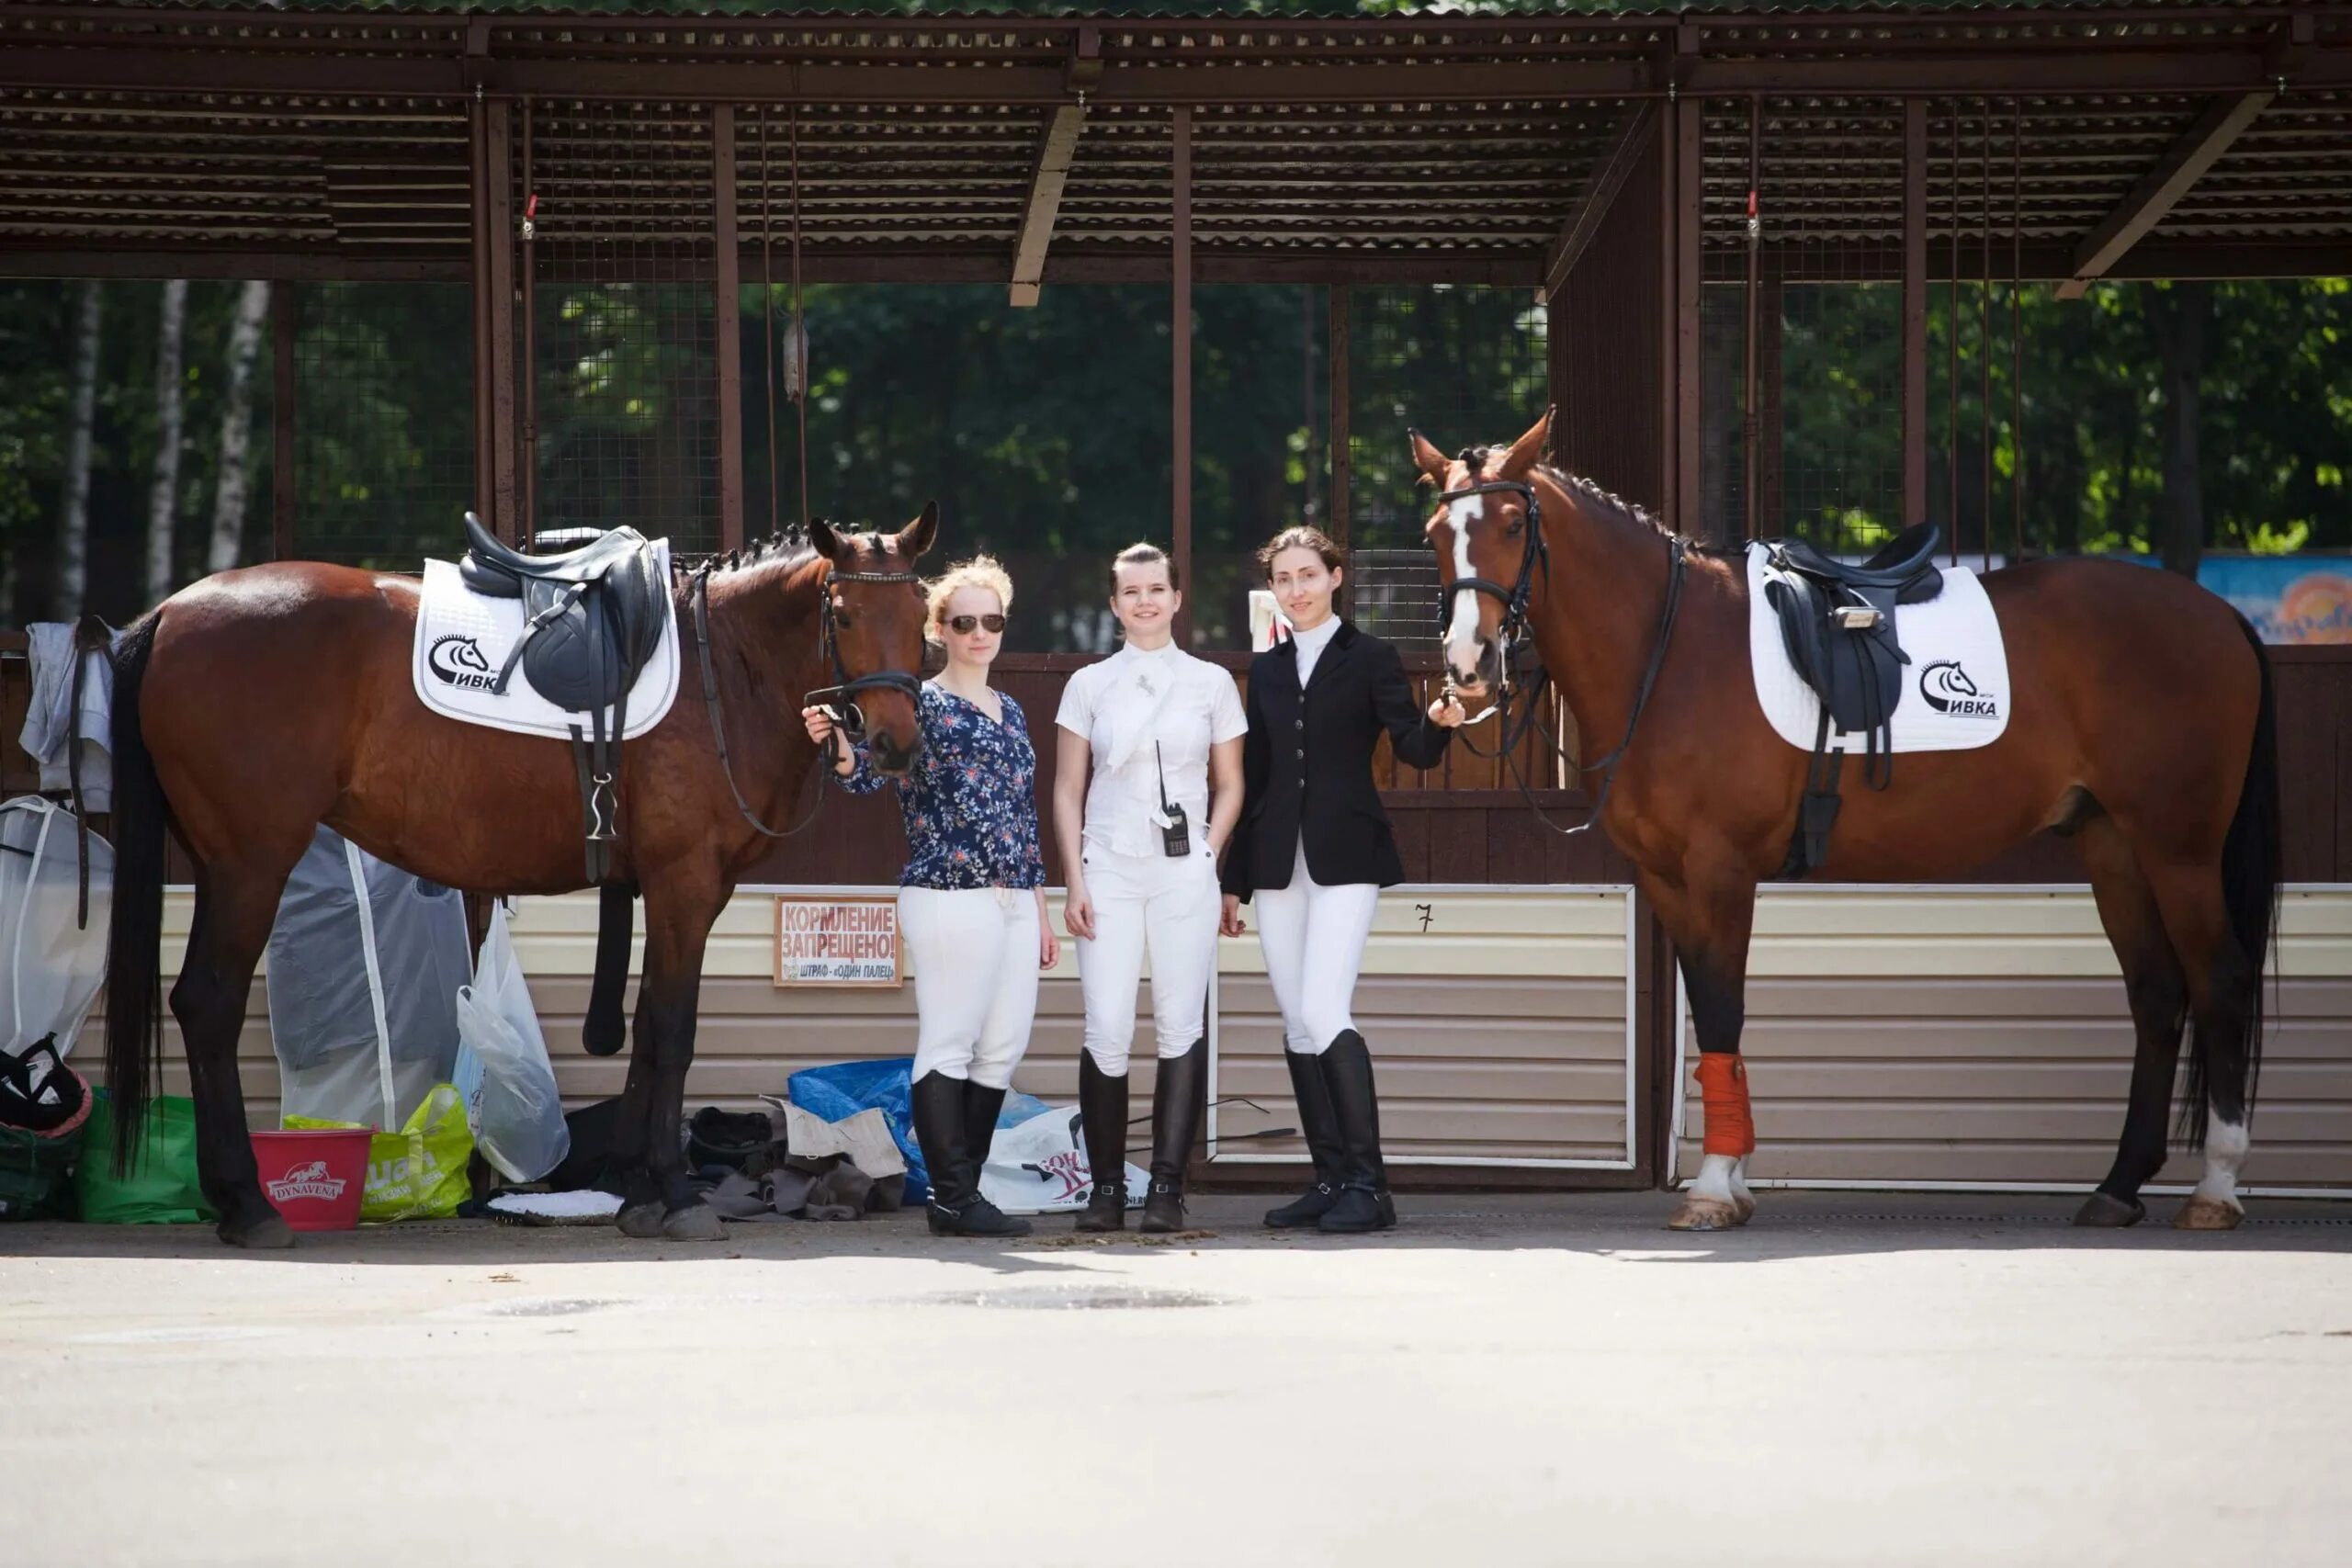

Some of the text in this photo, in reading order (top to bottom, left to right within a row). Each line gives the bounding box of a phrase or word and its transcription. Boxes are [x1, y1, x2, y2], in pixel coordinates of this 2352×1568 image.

[456, 672, 498, 690] ИВК
[1950, 700, 1996, 716] ИВКА
[785, 906, 893, 932] КОРМЛЕНИЕ
[1415, 904, 1434, 933] 7
[783, 933, 895, 964] ЗАПРЕЩЕНО!
[799, 964, 829, 977] ШТРАФ
[276, 1183, 337, 1199] DYNAVENA
